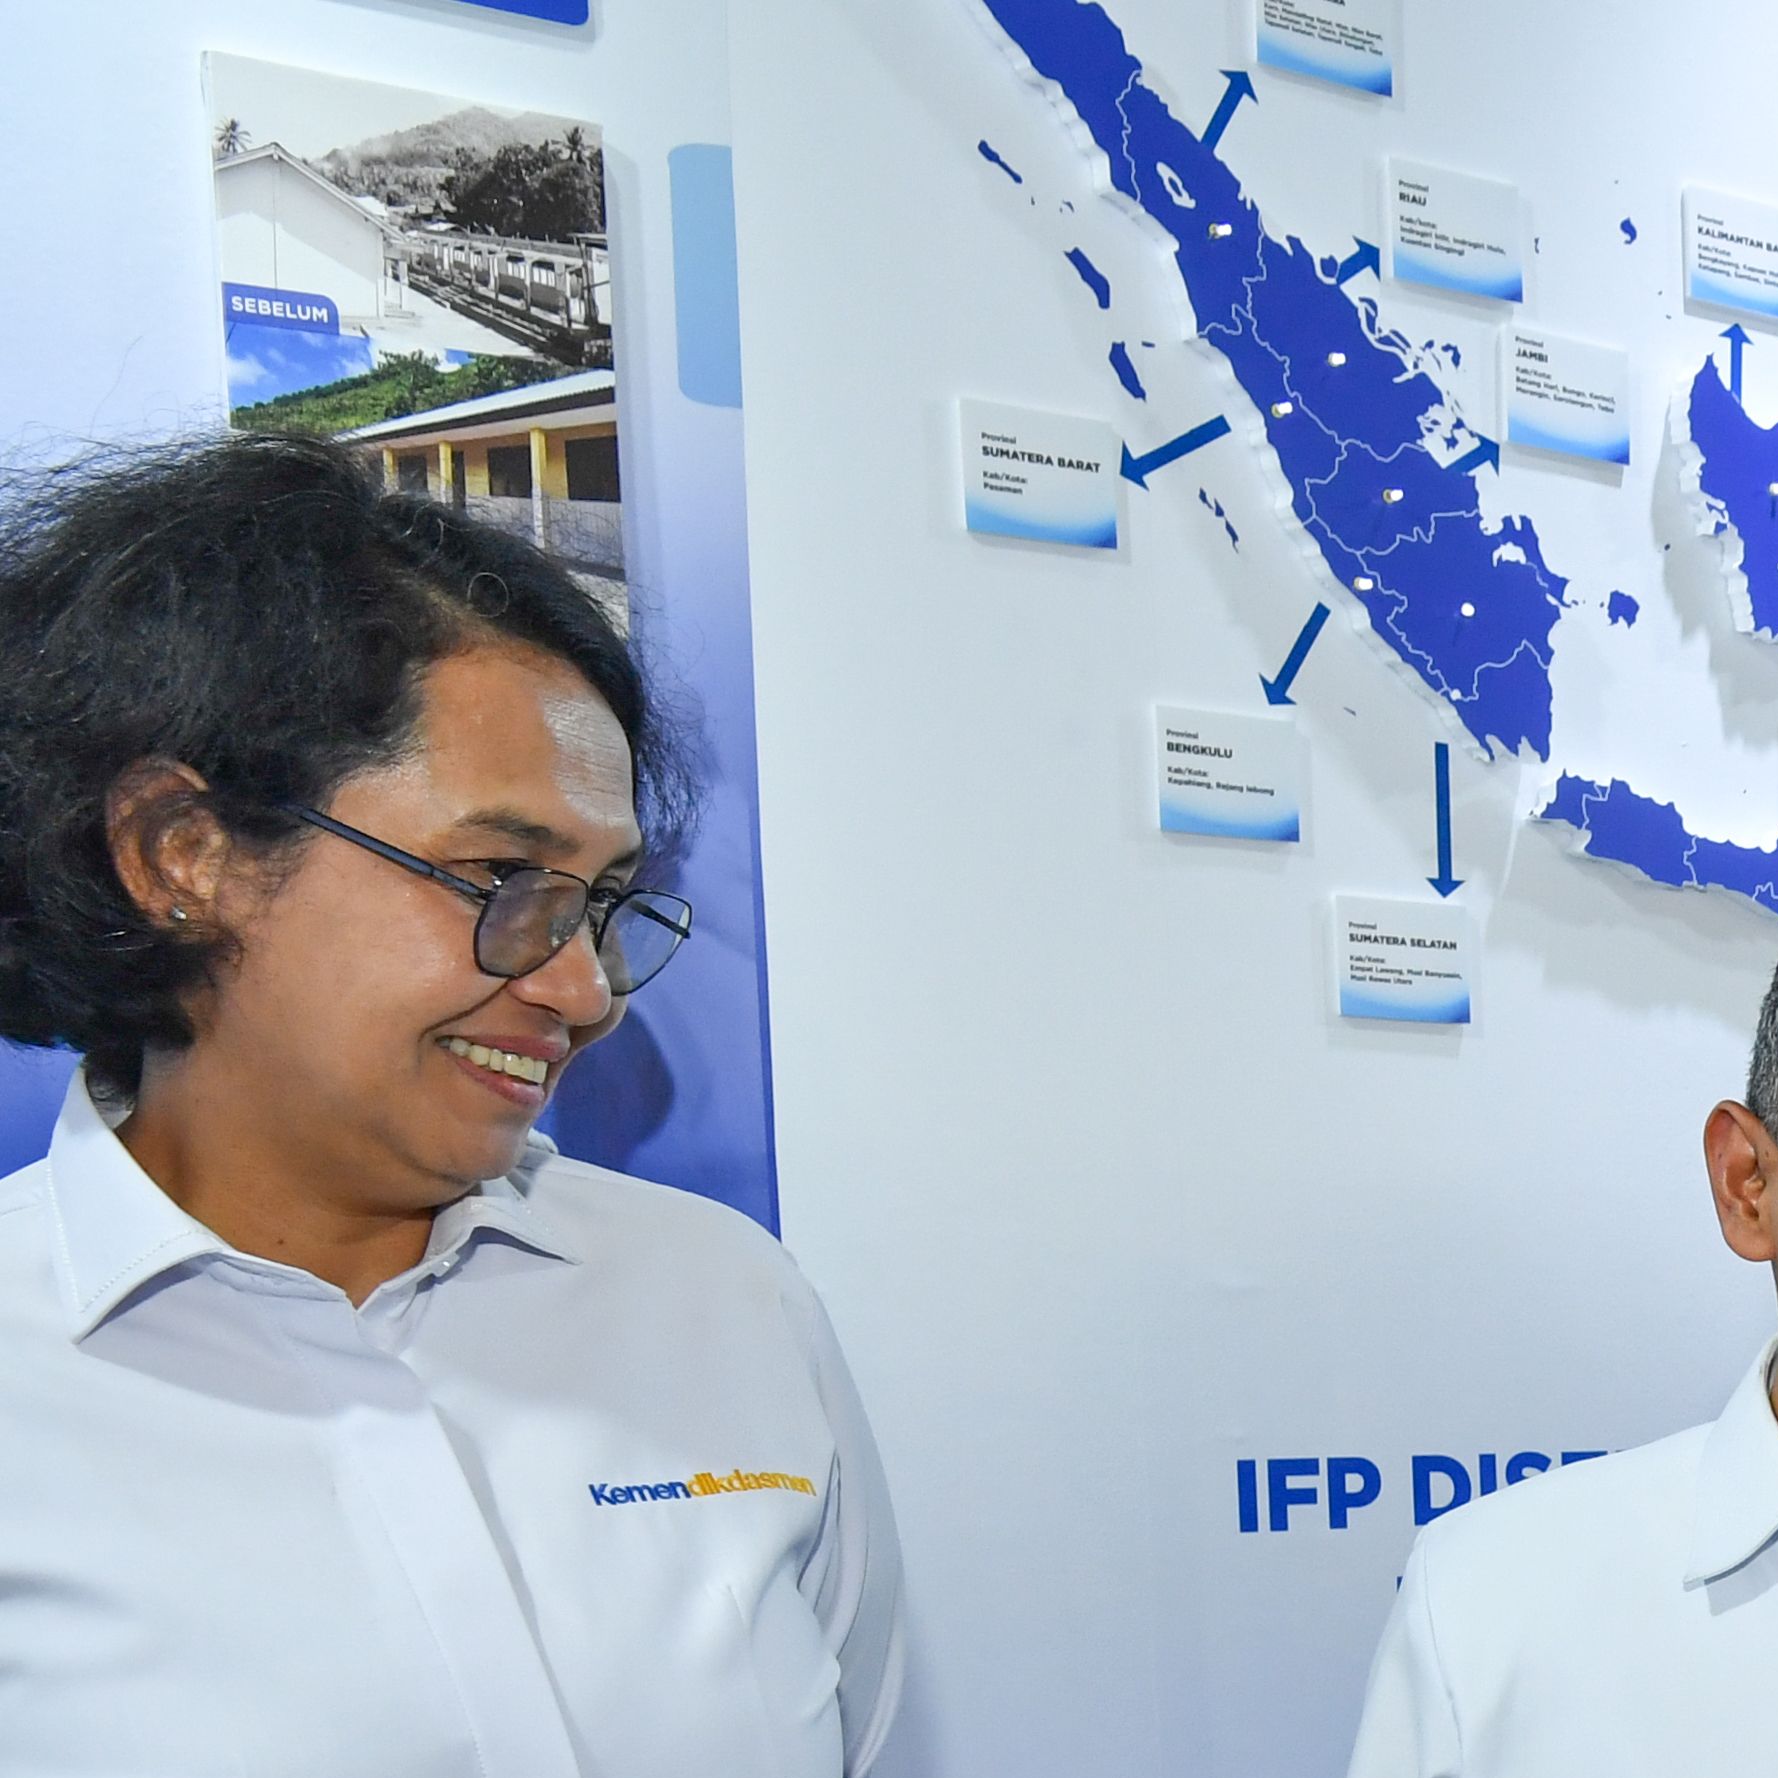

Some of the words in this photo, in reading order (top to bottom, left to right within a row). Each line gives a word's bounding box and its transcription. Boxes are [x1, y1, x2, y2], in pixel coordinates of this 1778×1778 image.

[1399, 192, 1427, 206] RIAU
[1698, 225, 1763, 250] KALIMANTAN
[231, 295, 329, 323] SEBELUM
[1516, 348, 1548, 364] JAMBI
[981, 432, 1017, 444] Provinsi
[982, 445, 1054, 466] SUMATERA
[1057, 456, 1101, 473] BARAT
[1166, 729, 1199, 741] Provinsi
[1167, 742, 1233, 759] BENGKULU
[1348, 932, 1407, 947] SUMATERA
[1409, 936, 1457, 951] SELATAN
[588, 1469, 817, 1506] Kemendikdasmen
[1236, 1457, 1381, 1533] IFP
